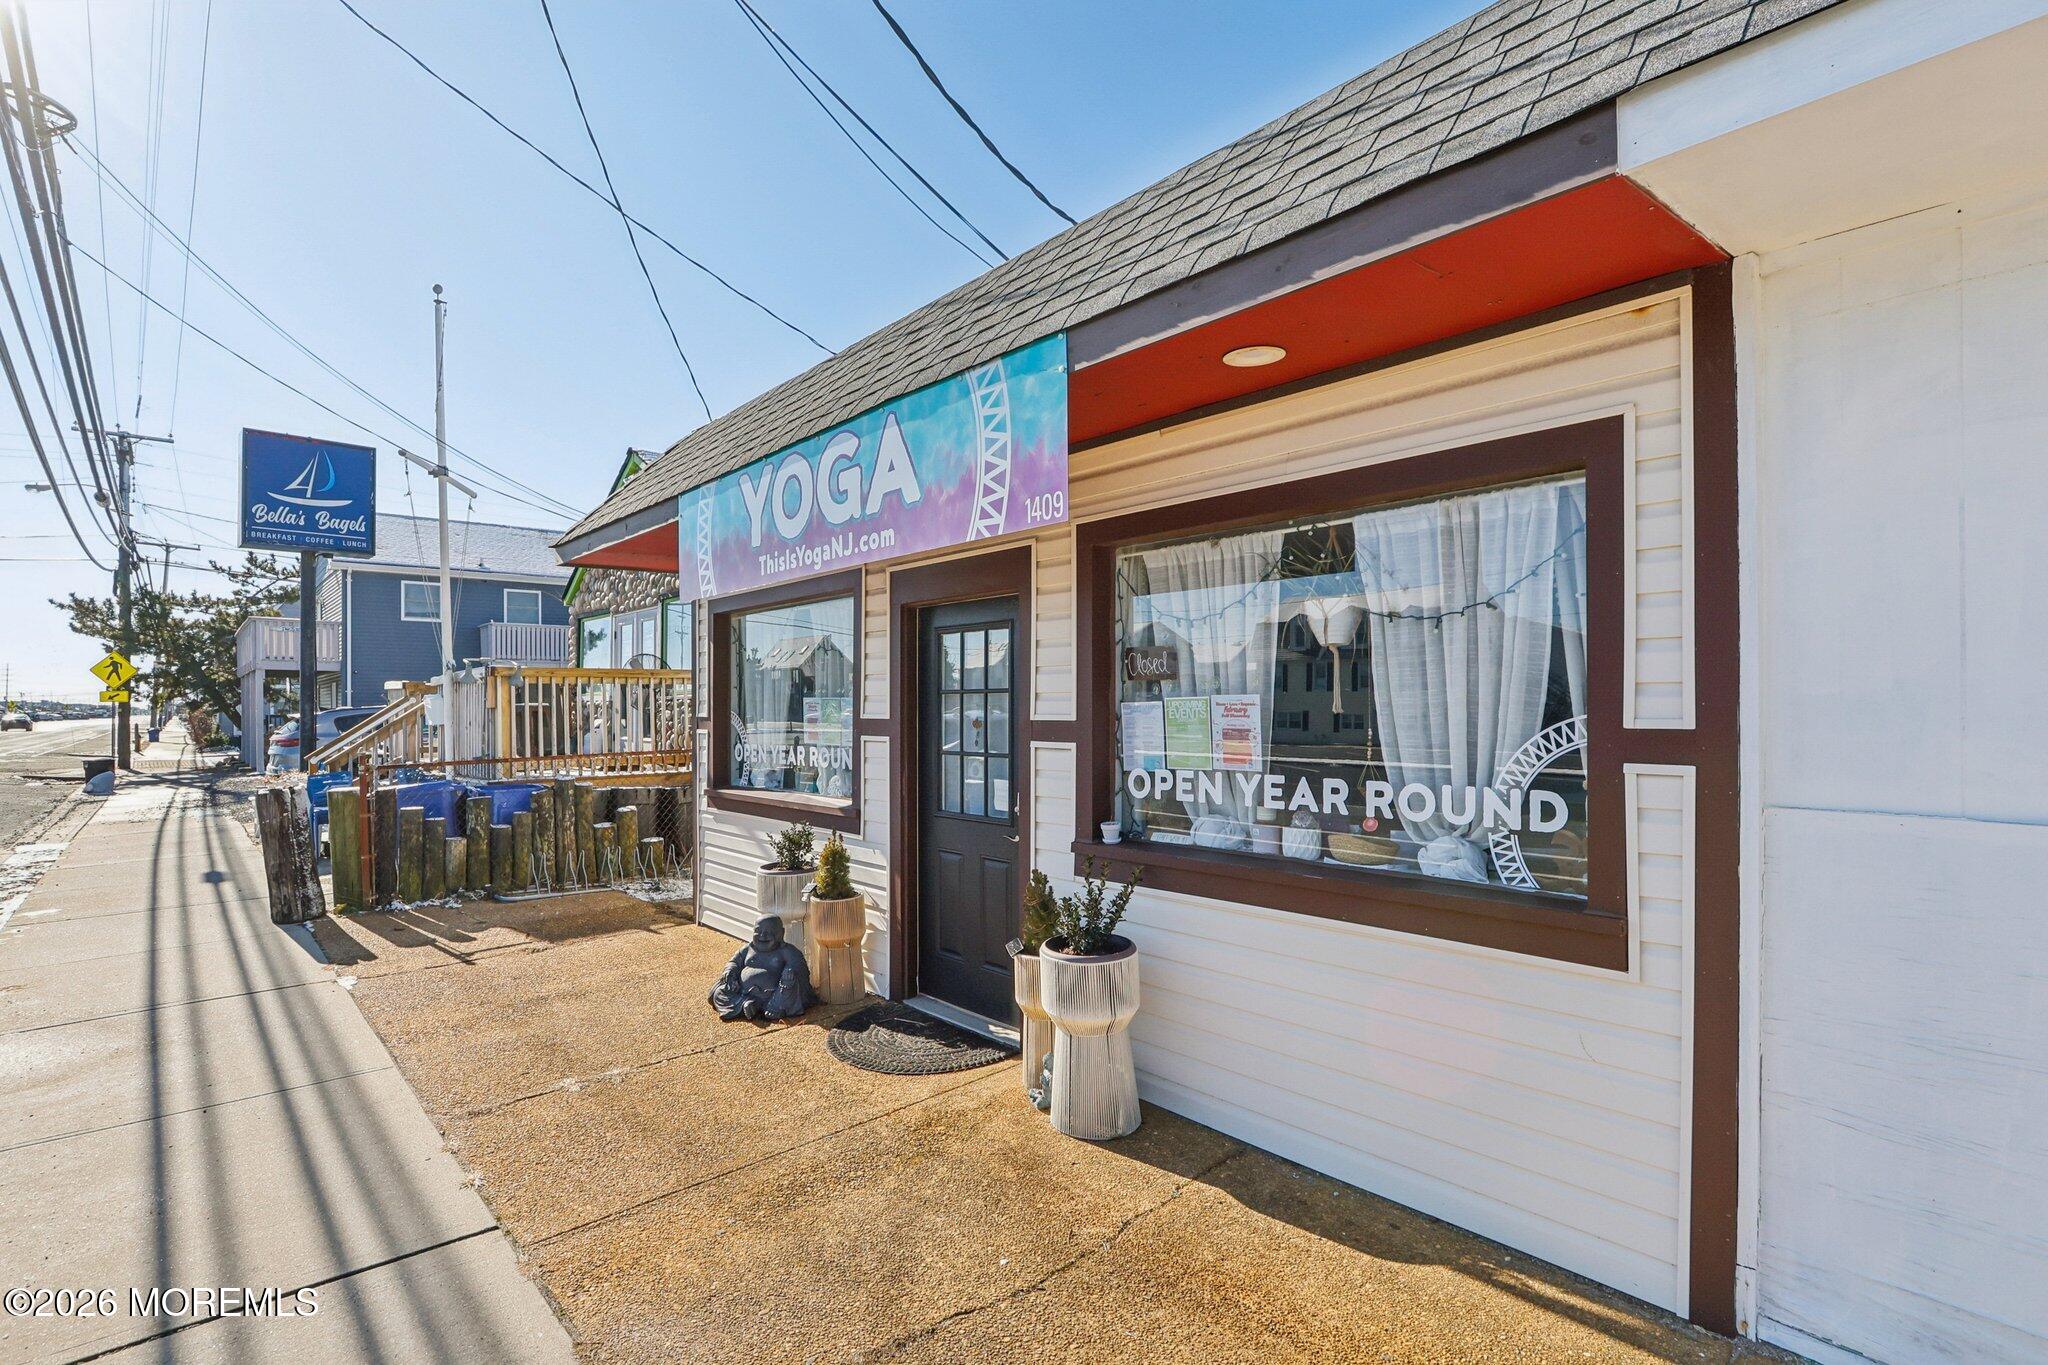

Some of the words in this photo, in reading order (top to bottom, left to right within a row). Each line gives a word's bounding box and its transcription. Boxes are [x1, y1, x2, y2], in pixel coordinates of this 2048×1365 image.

[738, 410, 921, 548] YOGA
[252, 504, 306, 526] Bella's
[315, 511, 366, 534] Bagels
[1024, 490, 1064, 524] 1409
[251, 531, 297, 542] BREAKFAST
[305, 536, 335, 546] COFFEE
[342, 540, 368, 549] LUNCH
[758, 526, 895, 577] ThisIsYogaNJ.com
[1128, 650, 1170, 677] Closed
[1168, 700, 1208, 709] UPCOMING
[1168, 708, 1207, 719] EVENTS
[734, 742, 767, 764] OPEN
[771, 746, 806, 768] YEAR
[1127, 767, 1222, 805] OPEN
[1236, 773, 1349, 815] YEAR
[1366, 780, 1569, 833] ROUND
